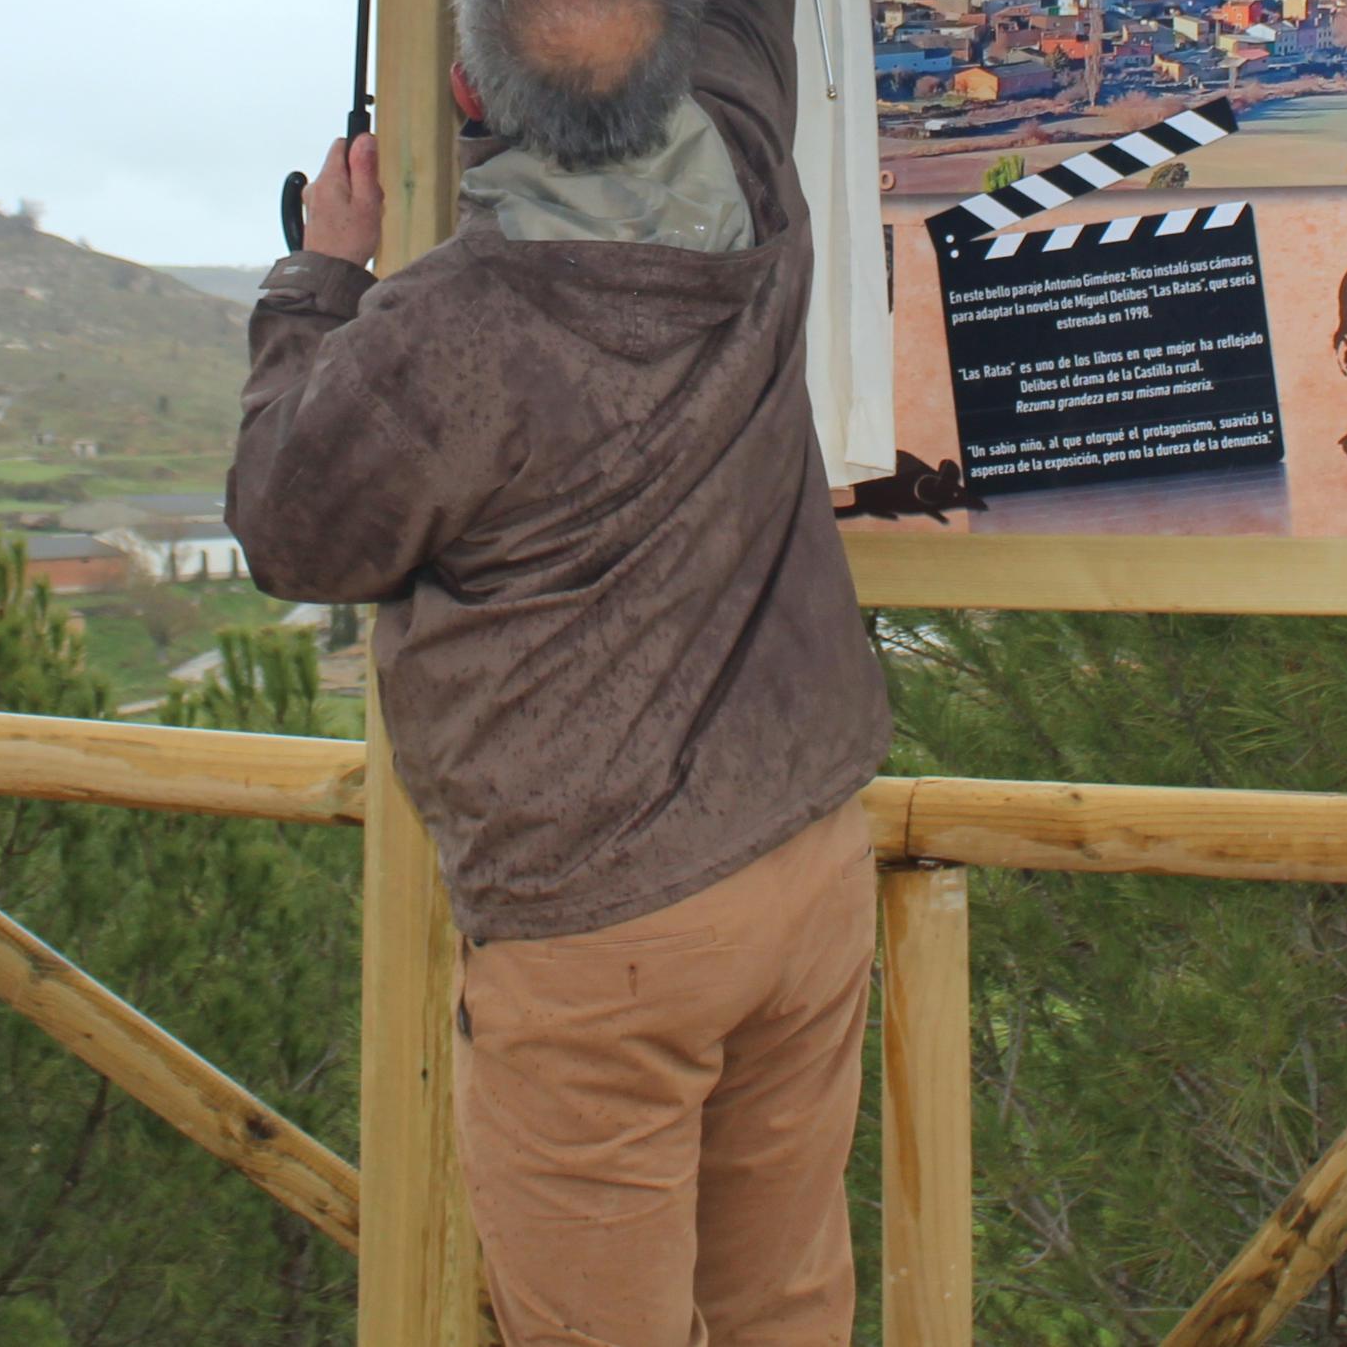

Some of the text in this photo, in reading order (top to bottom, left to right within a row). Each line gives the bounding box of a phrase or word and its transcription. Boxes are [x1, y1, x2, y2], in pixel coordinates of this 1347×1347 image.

[950, 254, 1253, 304] En este bello paraje Antonio Giménez-Rico instaló sus cámaras
[952, 310, 974, 326] para
[976, 305, 1013, 321] adaptar
[1015, 303, 1024, 315] la
[1026, 297, 1060, 314] novela
[1061, 297, 1073, 309] de
[1075, 291, 1109, 309] Miguel
[1110, 288, 1148, 303] Delibes
[1209, 279, 1228, 292] que
[1230, 272, 1256, 287] sería
[1056, 305, 1152, 330] estrenada en 1998.
[1020, 363, 1032, 374] es
[1035, 360, 1054, 372] uno
[1058, 356, 1071, 369] de
[1074, 354, 1090, 367] los
[1093, 350, 1123, 365] libros
[1127, 349, 1139, 360] en
[1143, 346, 1163, 360] que
[1166, 341, 1196, 357] mejor
[1200, 338, 1214, 351] ha
[1217, 332, 1263, 349] reflejado
[1016, 378, 1214, 414] Rezuma grandeza en su misma miseria.
[1020, 359, 1203, 393] Delibes el drama de la Castilla rural.
[989, 441, 1016, 456] sabio
[1020, 438, 1046, 452] niño,
[1049, 436, 1059, 449] al
[1063, 434, 1082, 449] que
[1086, 428, 1124, 445] otorgué
[1129, 426, 1139, 440] el
[1143, 420, 1216, 441] protagonismo,
[1220, 412, 1259, 428] suavizó
[1262, 411, 1273, 424] la
[971, 462, 1015, 479] aspereza
[1017, 459, 1030, 472] de
[1032, 458, 1042, 471] la
[1045, 451, 1101, 470] exposición,
[1104, 451, 1125, 465] pero
[1128, 449, 1141, 460] no
[1144, 445, 1154, 458] la
[1156, 442, 1191, 457] dureza
[1193, 439, 1206, 452] de
[1208, 438, 1219, 450] la
